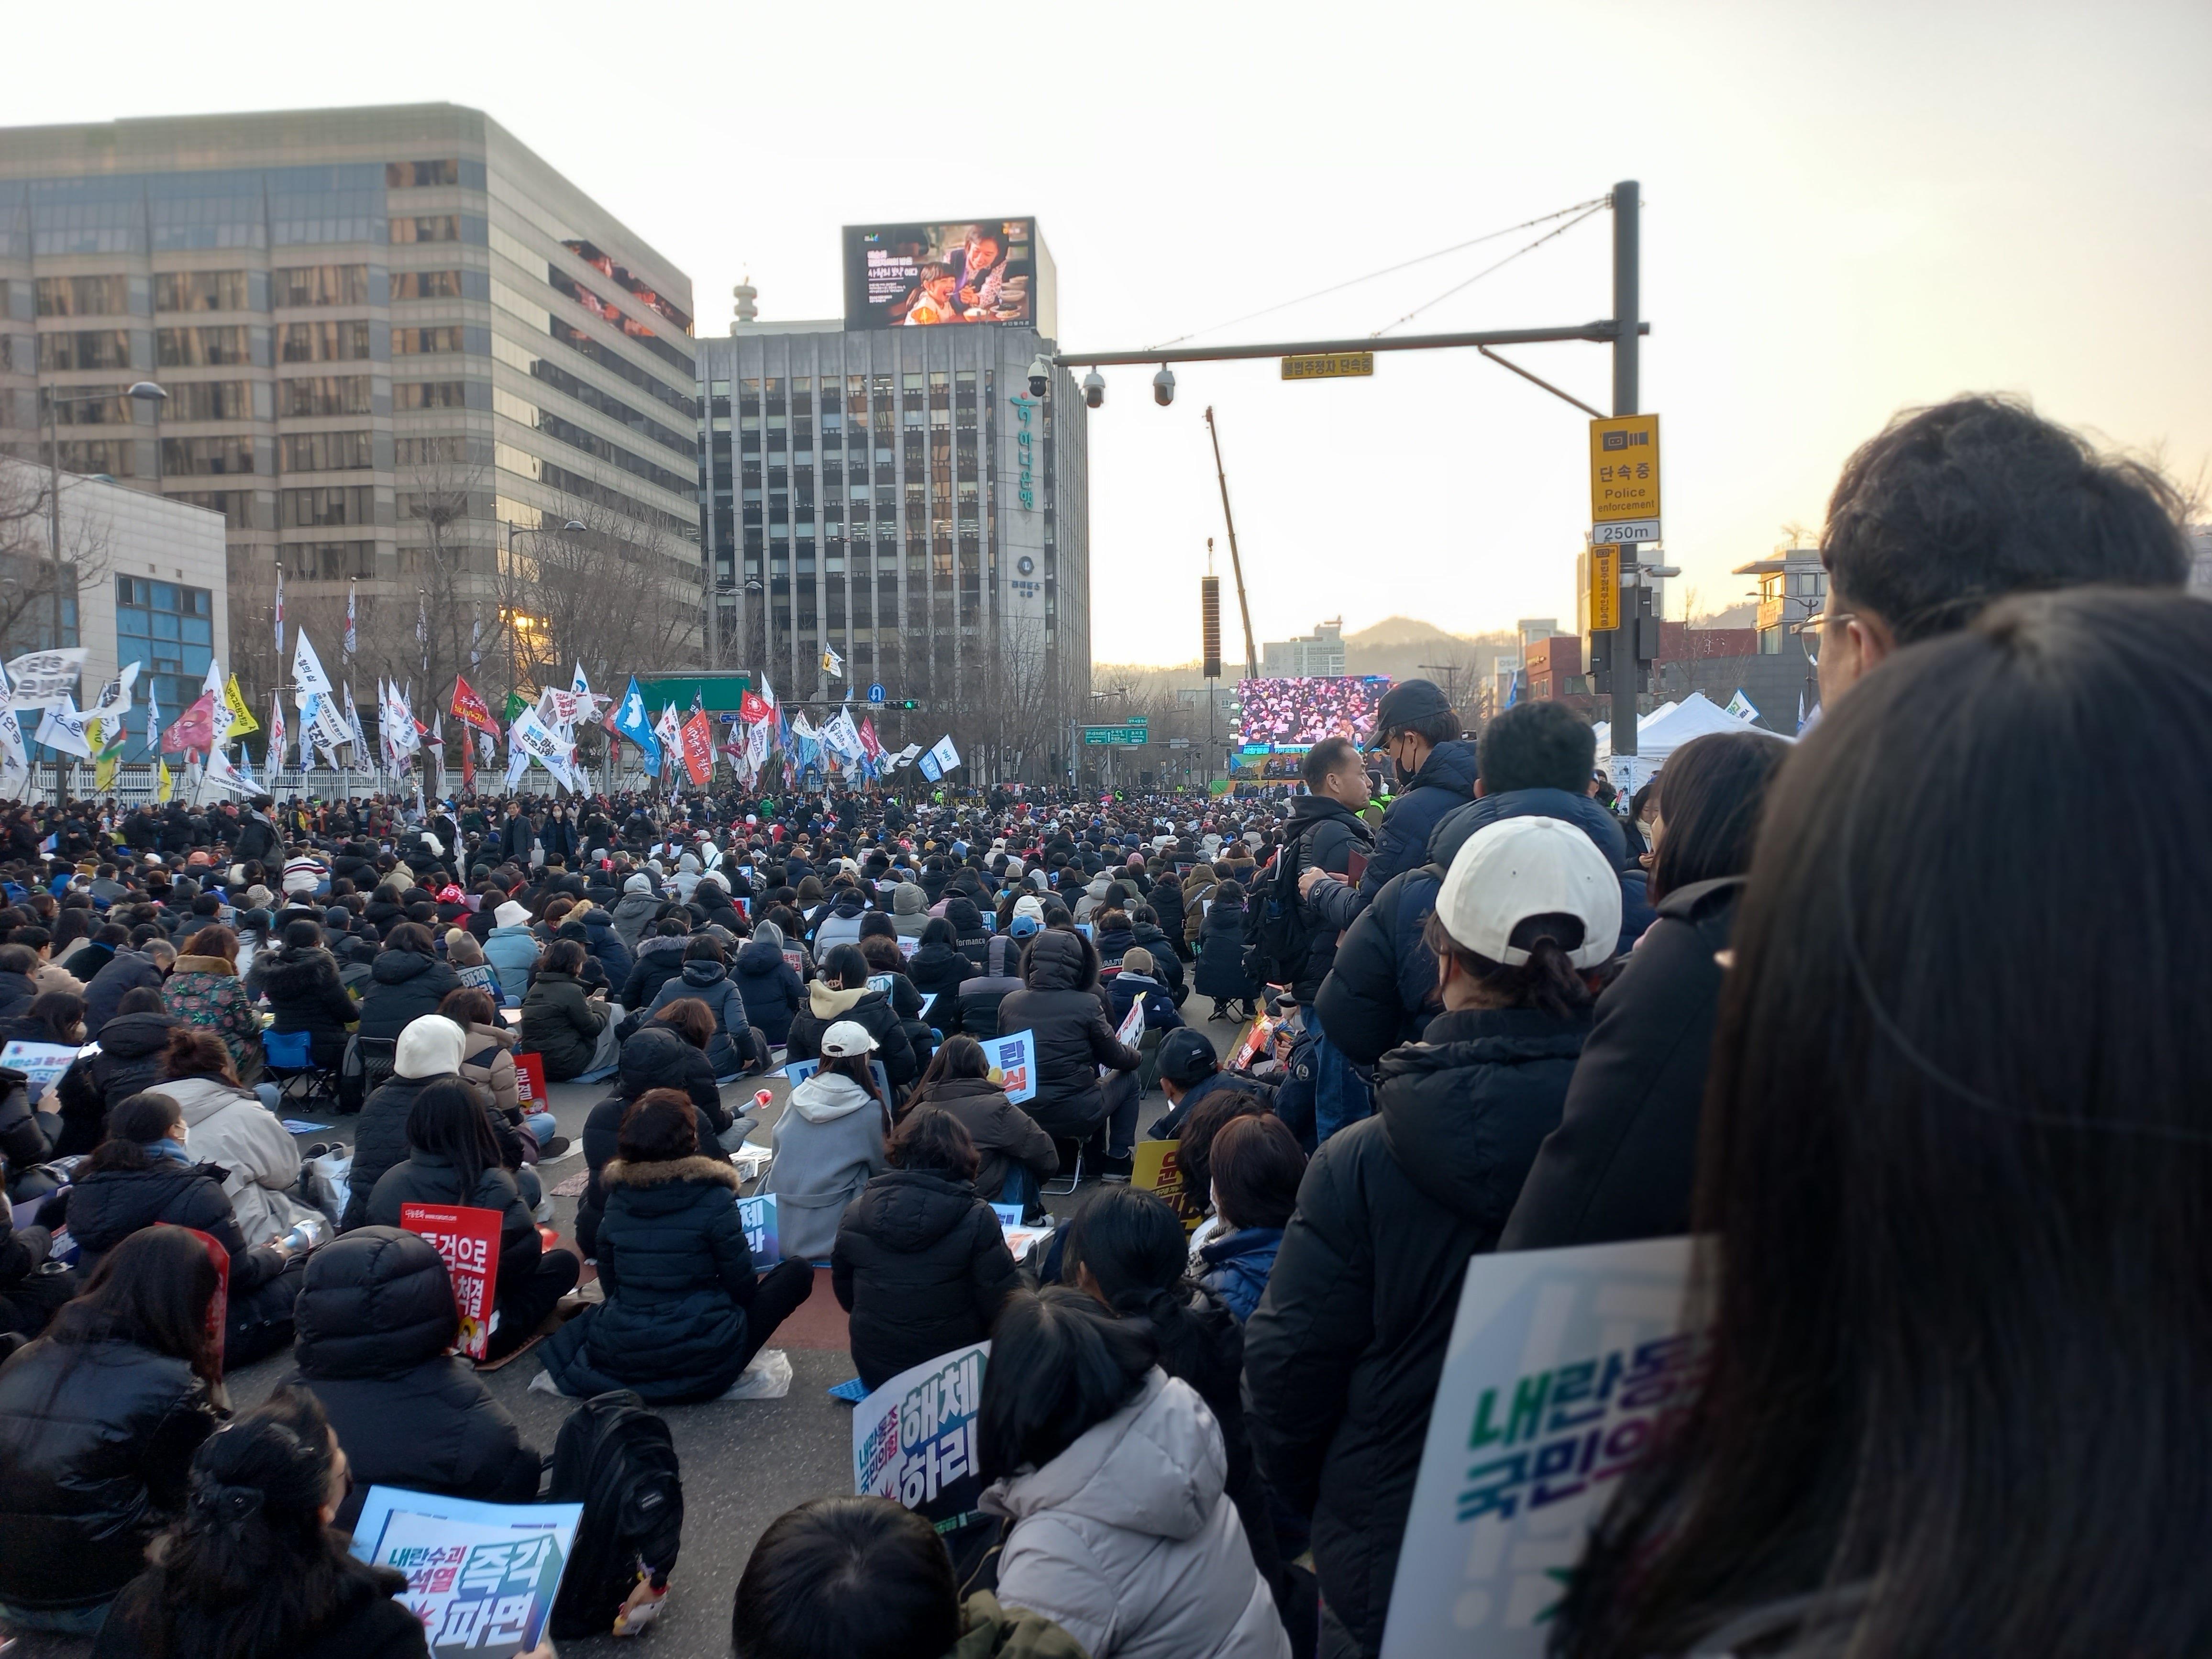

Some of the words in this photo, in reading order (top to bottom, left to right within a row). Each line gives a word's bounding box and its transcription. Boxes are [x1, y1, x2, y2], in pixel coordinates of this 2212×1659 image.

[1284, 360, 1336, 376] 불법주정차
[1340, 357, 1371, 373] 단속중
[1018, 431, 1034, 510] 하나은행
[1600, 463, 1650, 483] 단속중
[1598, 499, 1655, 513] enforcement
[1605, 487, 1646, 499] Police
[1604, 526, 1648, 540] 250m
[316, 693, 347, 740] 비스산업노동조합연맹
[521, 731, 554, 757] 간호사회
[686, 725, 705, 758] 비정규직
[697, 757, 710, 778] 철폐
[921, 755, 939, 778] 남양주
[460, 967, 490, 988] 해체
[457, 1274, 485, 1319] 척결
[901, 1353, 980, 1449] 해체
[859, 1404, 899, 1471] 내란동조
[900, 1417, 980, 1510] 하라
[388, 1545, 468, 1568] 내란수괴
[461, 1535, 552, 1594] 즉각
[408, 1567, 459, 1595] 석열
[434, 1590, 536, 1651] 파면
